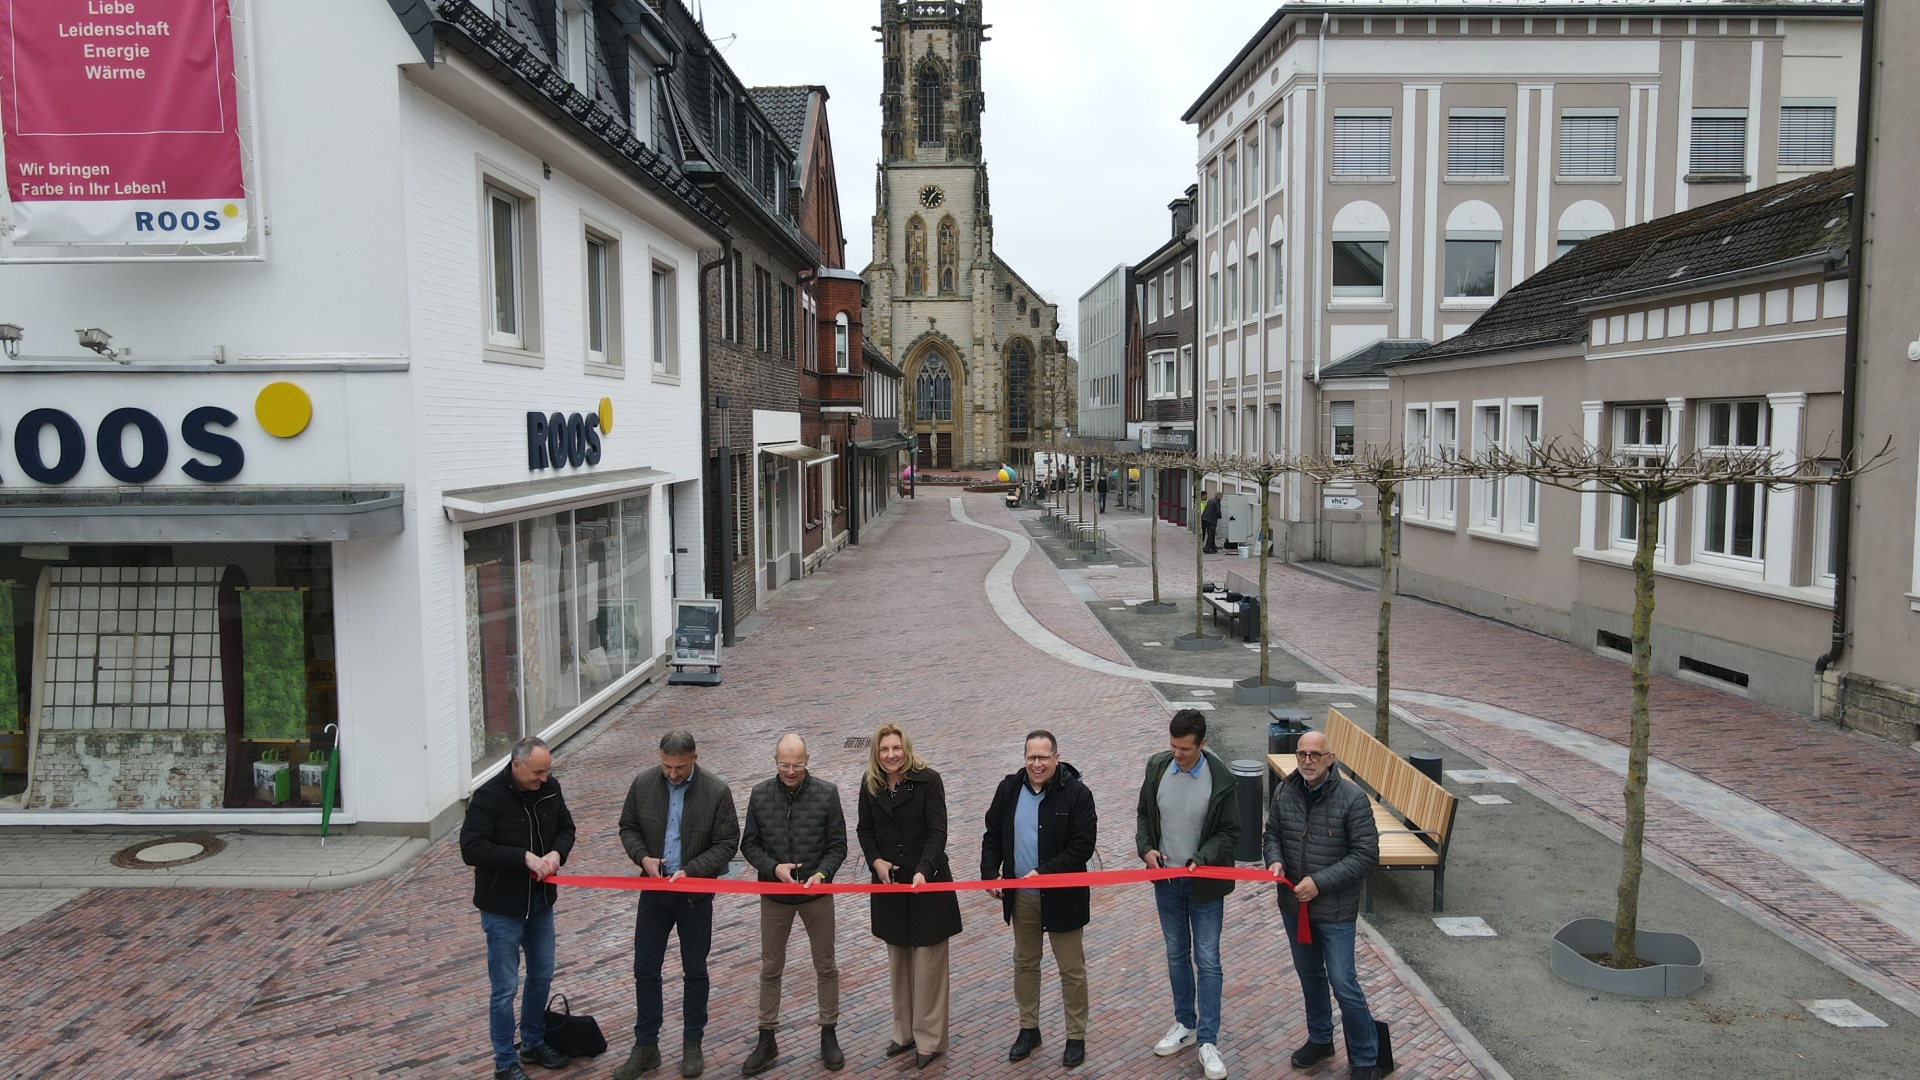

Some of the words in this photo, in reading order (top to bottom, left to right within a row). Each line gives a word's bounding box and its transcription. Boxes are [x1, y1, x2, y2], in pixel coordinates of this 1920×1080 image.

[88, 0, 135, 15] Liebe
[59, 21, 170, 37] Leidenschaft
[83, 43, 150, 61] Energie
[85, 65, 146, 80] Wärme
[19, 163, 44, 176] Wir
[48, 163, 110, 179] bringen
[21, 182, 64, 196] Farbe
[69, 183, 84, 195] in
[89, 182, 110, 195] Ihr
[114, 181, 167, 195] Leben!
[135, 210, 221, 232] ROOS
[0, 406, 245, 484] OOS
[527, 411, 602, 469] ROOS
